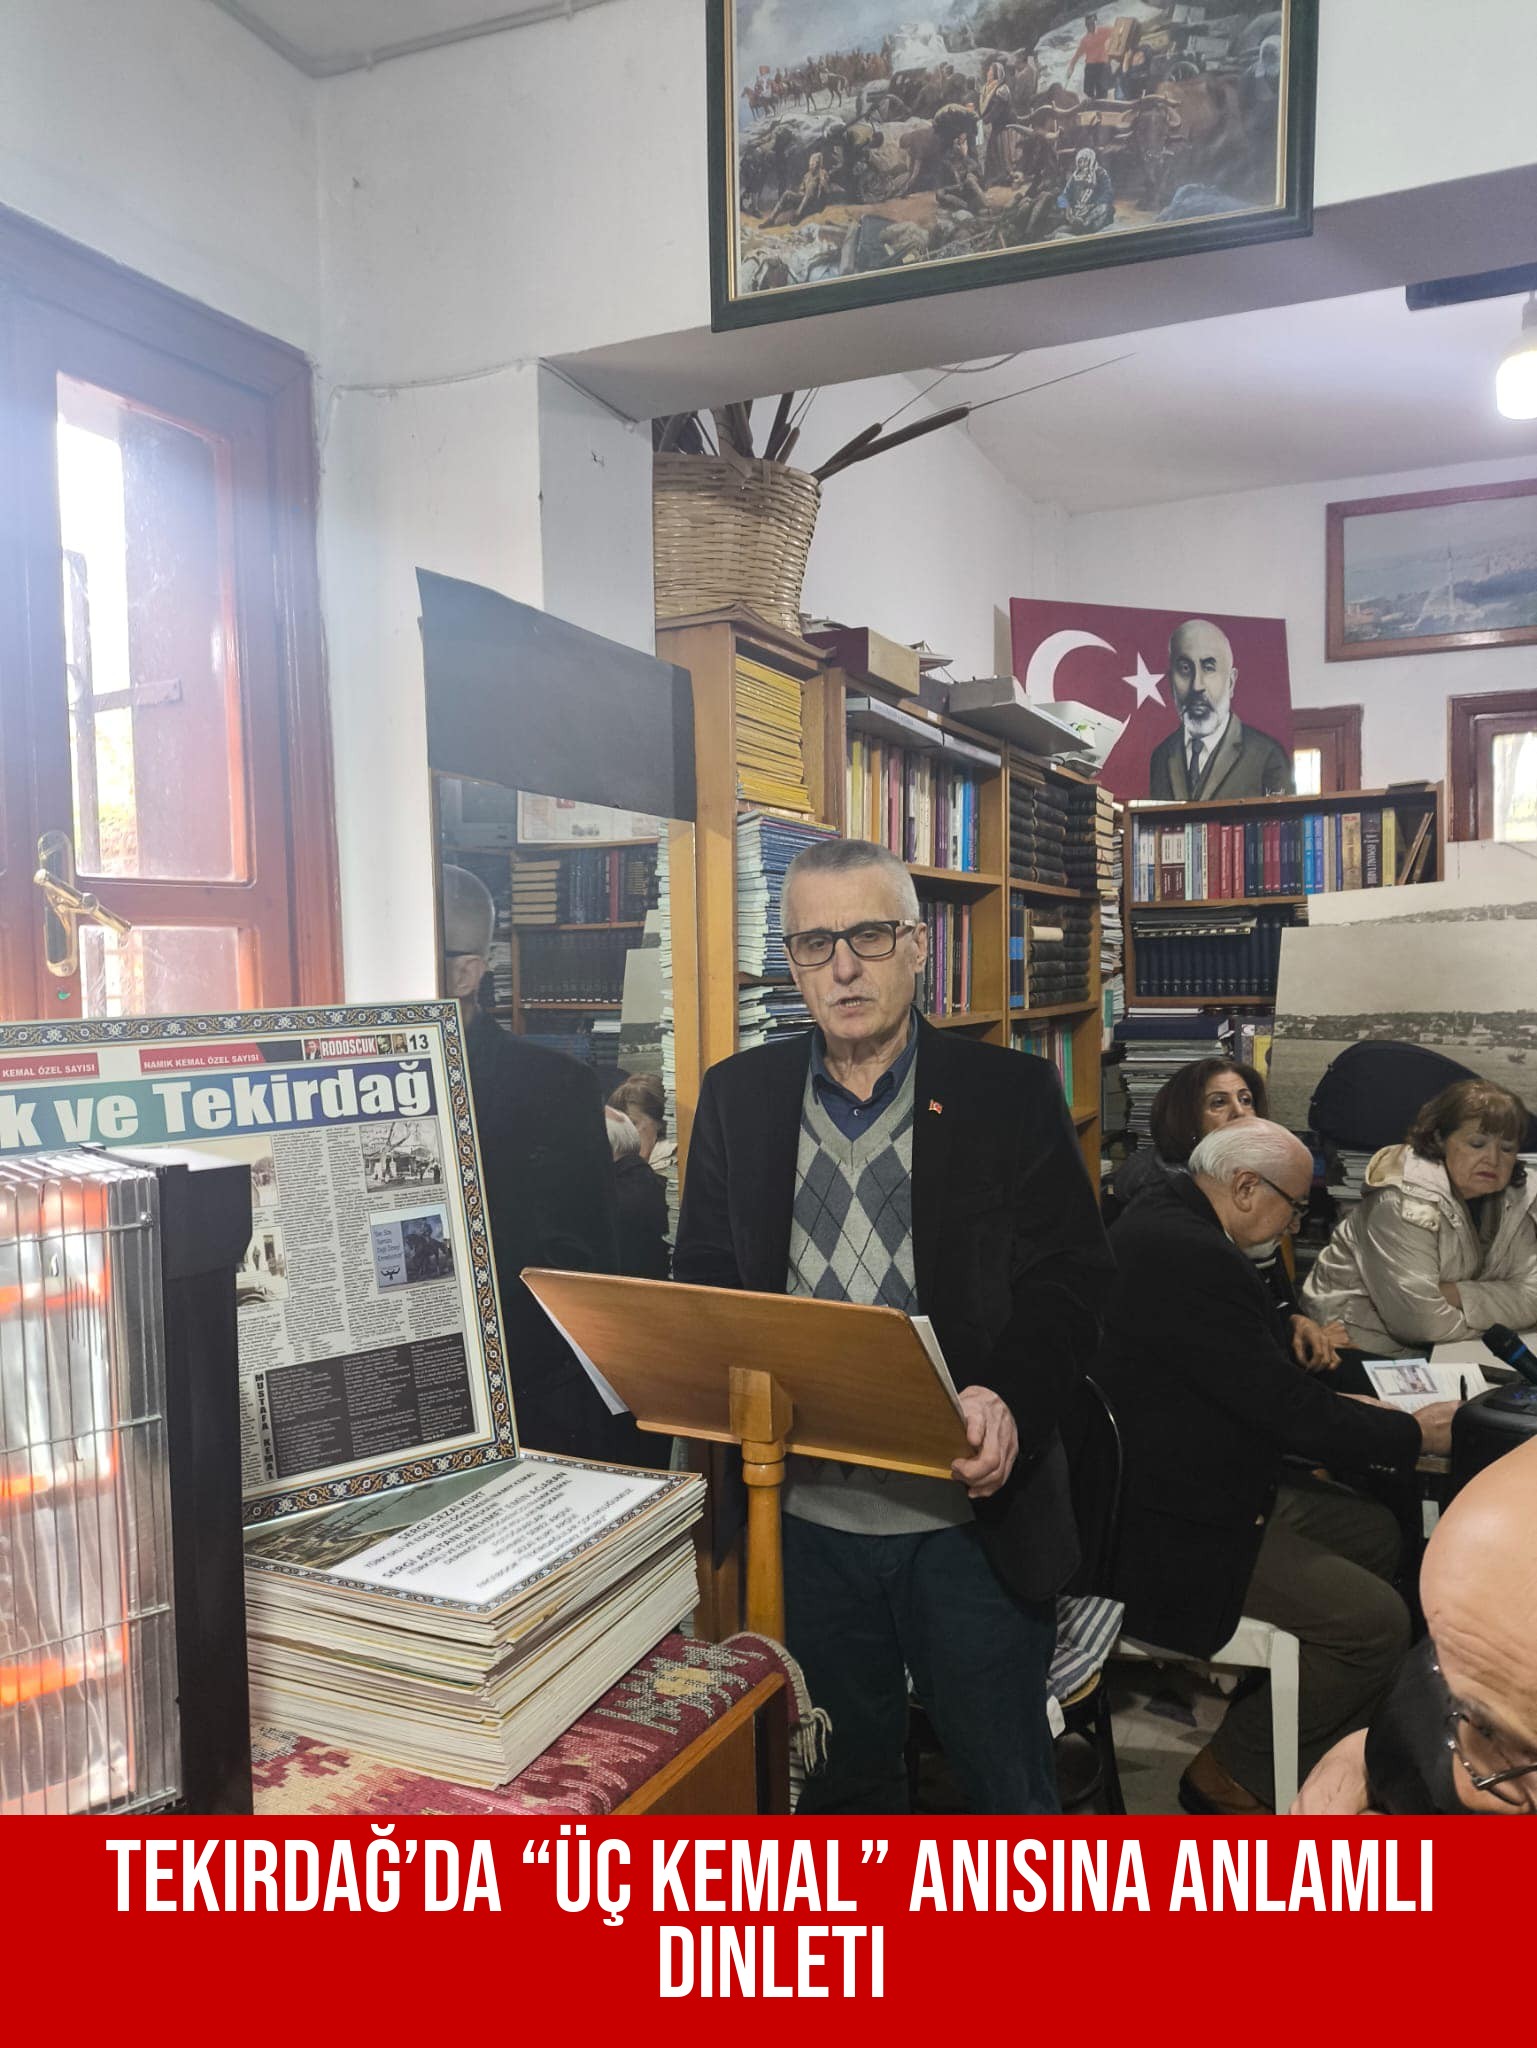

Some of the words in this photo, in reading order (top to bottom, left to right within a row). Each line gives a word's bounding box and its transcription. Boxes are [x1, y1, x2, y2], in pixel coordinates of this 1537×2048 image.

[408, 1034, 429, 1051] 13
[143, 1058, 174, 1070] NAMIK
[175, 1056, 206, 1067] KEMAL
[207, 1055, 230, 1066] ÖZEL
[232, 1053, 260, 1063] SAYISI
[2, 1066, 35, 1078] KEMAL
[38, 1064, 63, 1075] ÖZEL
[65, 1063, 95, 1074] SAYISI
[53, 1094, 139, 1143] ve
[151, 1060, 431, 1135] Tekirdağ
[255, 1374, 269, 1430] MUSTAFA
